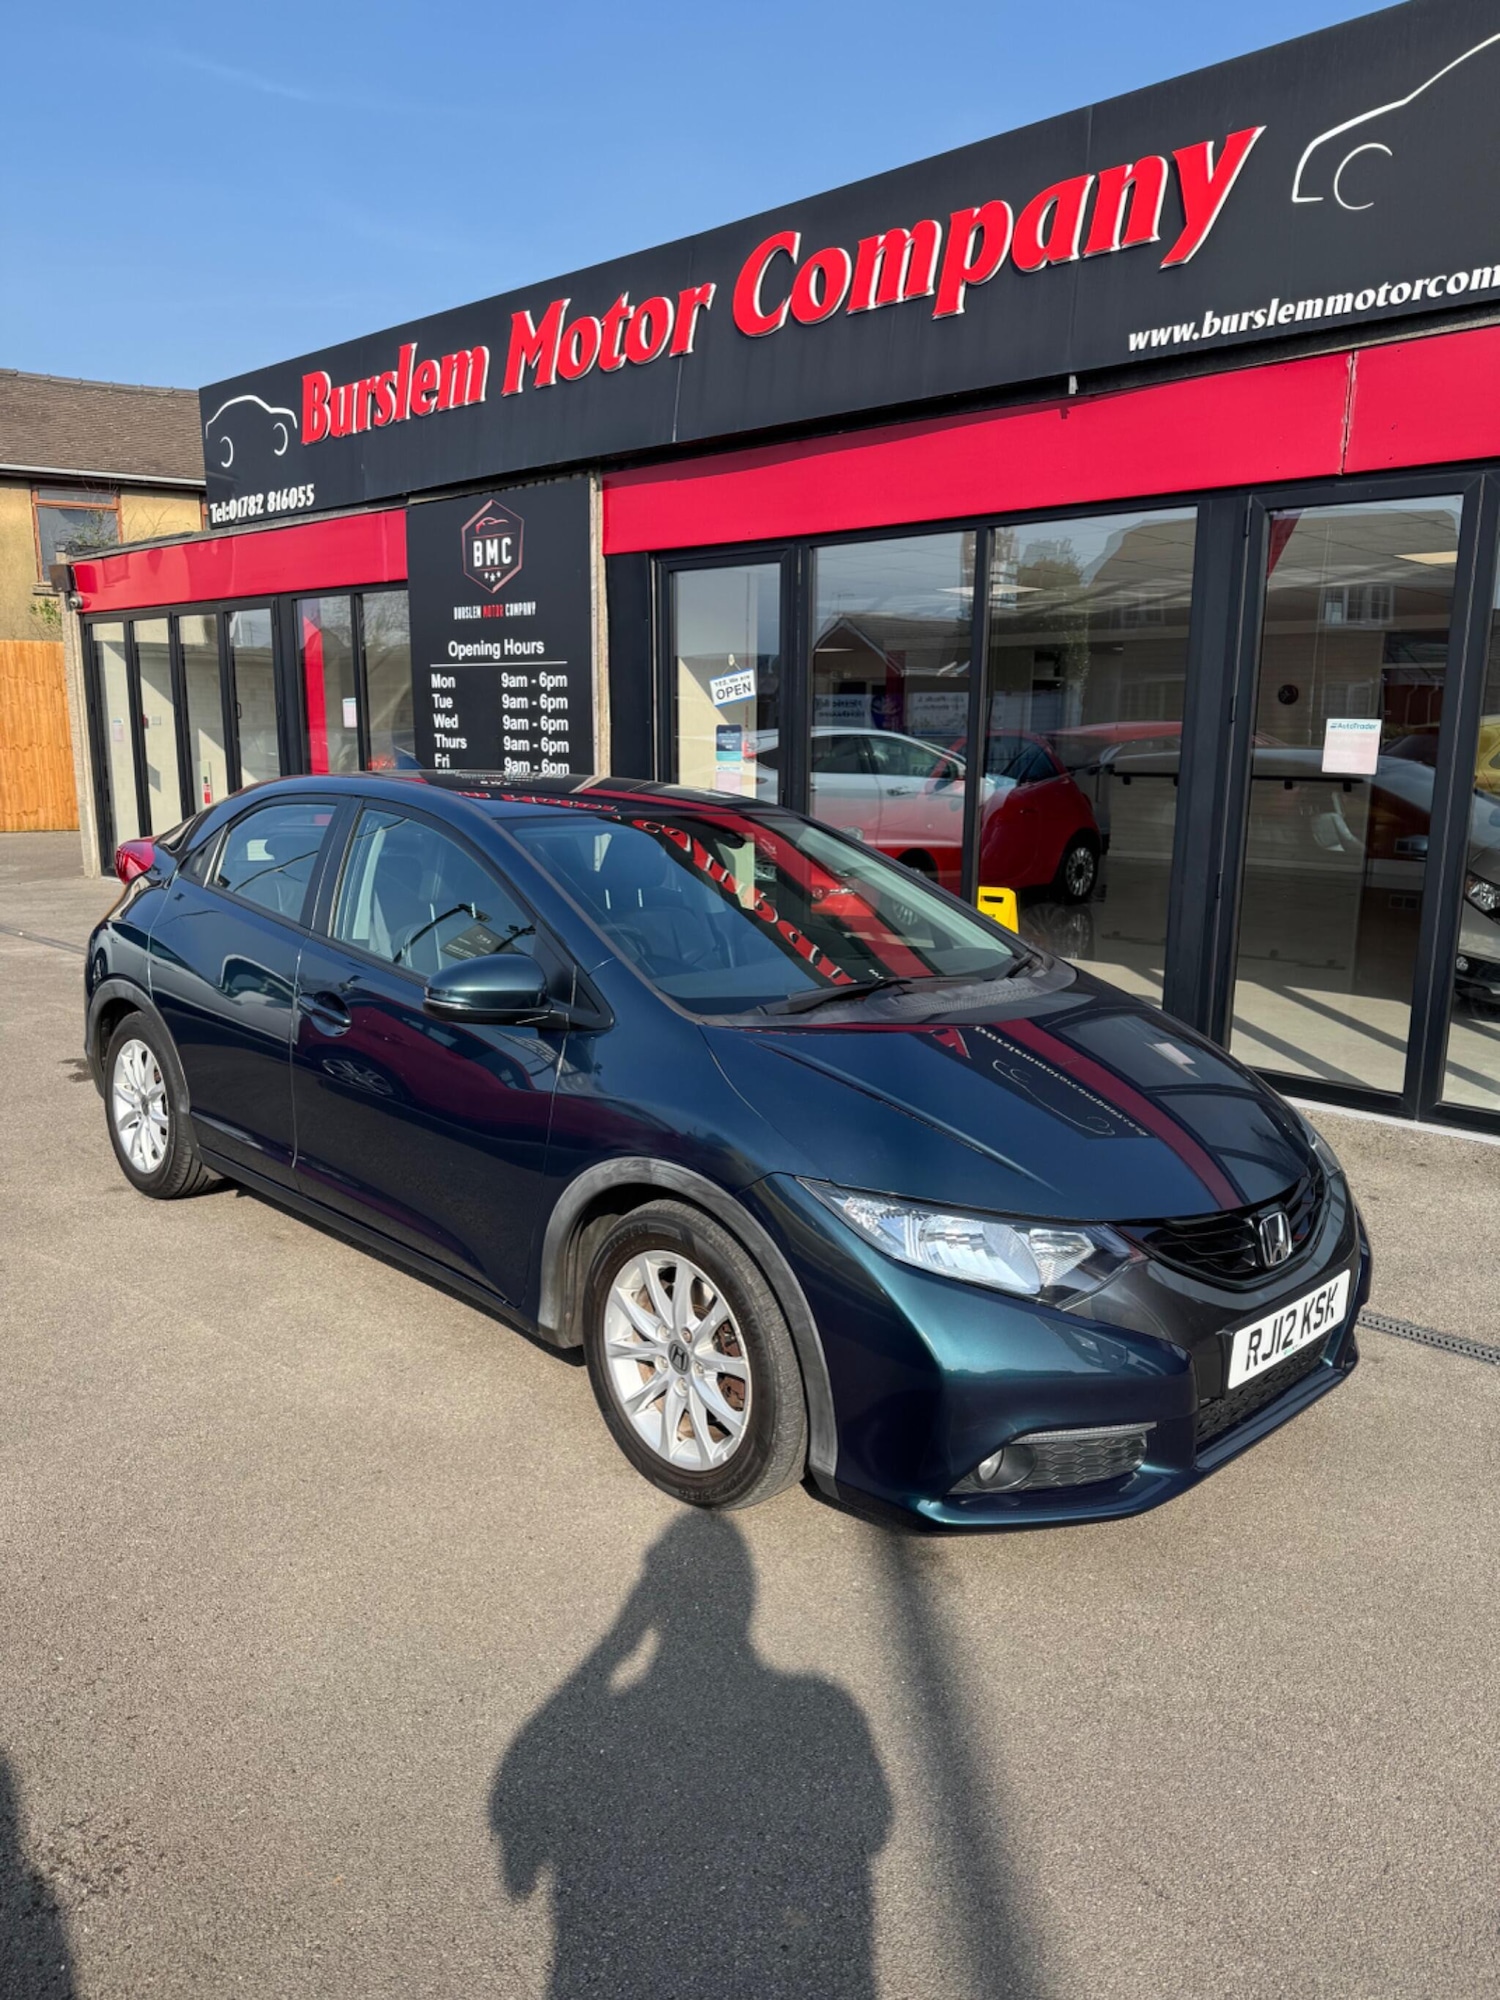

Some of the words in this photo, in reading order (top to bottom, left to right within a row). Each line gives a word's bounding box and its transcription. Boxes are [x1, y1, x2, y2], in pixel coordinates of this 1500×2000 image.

[302, 343, 490, 445] Burslem
[501, 283, 716, 397] Motor
[732, 126, 1267, 337] Company
[1128, 264, 1500, 352] www.burslemmotorcom
[267, 484, 315, 512] 816055
[473, 537, 512, 567] BMC
[448, 640, 500, 660] Opening
[504, 638, 545, 655] Hours
[431, 673, 456, 688] Mon
[501, 672, 528, 687] 9am
[539, 671, 568, 691] 6pm
[716, 682, 752, 700] OPEN
[432, 694, 453, 708] Tue
[502, 694, 529, 709] 9am
[540, 693, 568, 713] 6pm
[433, 713, 459, 728] Wed
[502, 715, 529, 730] 9am
[540, 715, 569, 735] 6pm
[434, 733, 467, 749] Thurs
[503, 736, 530, 751] 9am
[541, 737, 570, 756] 6pm
[434, 753, 451, 768] Fri
[1246, 1309, 1297, 1371] RJ12
[1300, 1282, 1339, 1339] KSK
